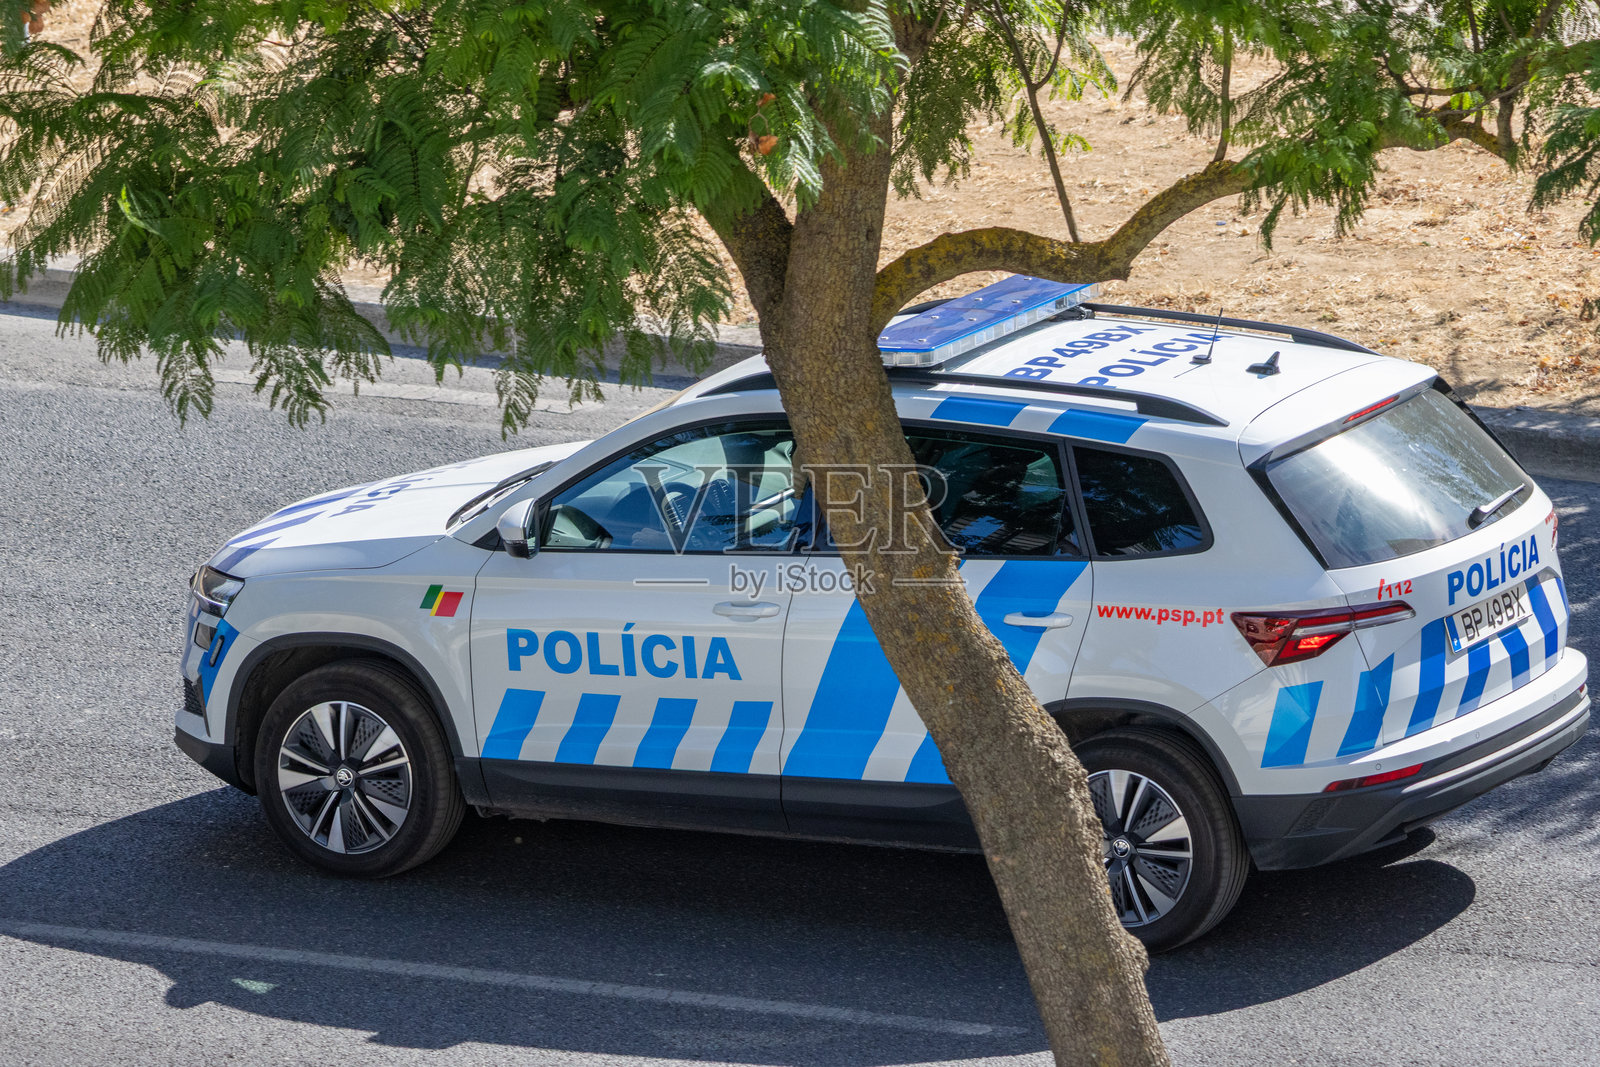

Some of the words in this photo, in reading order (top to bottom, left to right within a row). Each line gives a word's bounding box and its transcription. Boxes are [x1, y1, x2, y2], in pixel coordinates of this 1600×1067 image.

[1447, 534, 1540, 606] POLÍCIA
[1096, 605, 1224, 627] www.psp.pt
[506, 622, 742, 681] POLÍCIA
